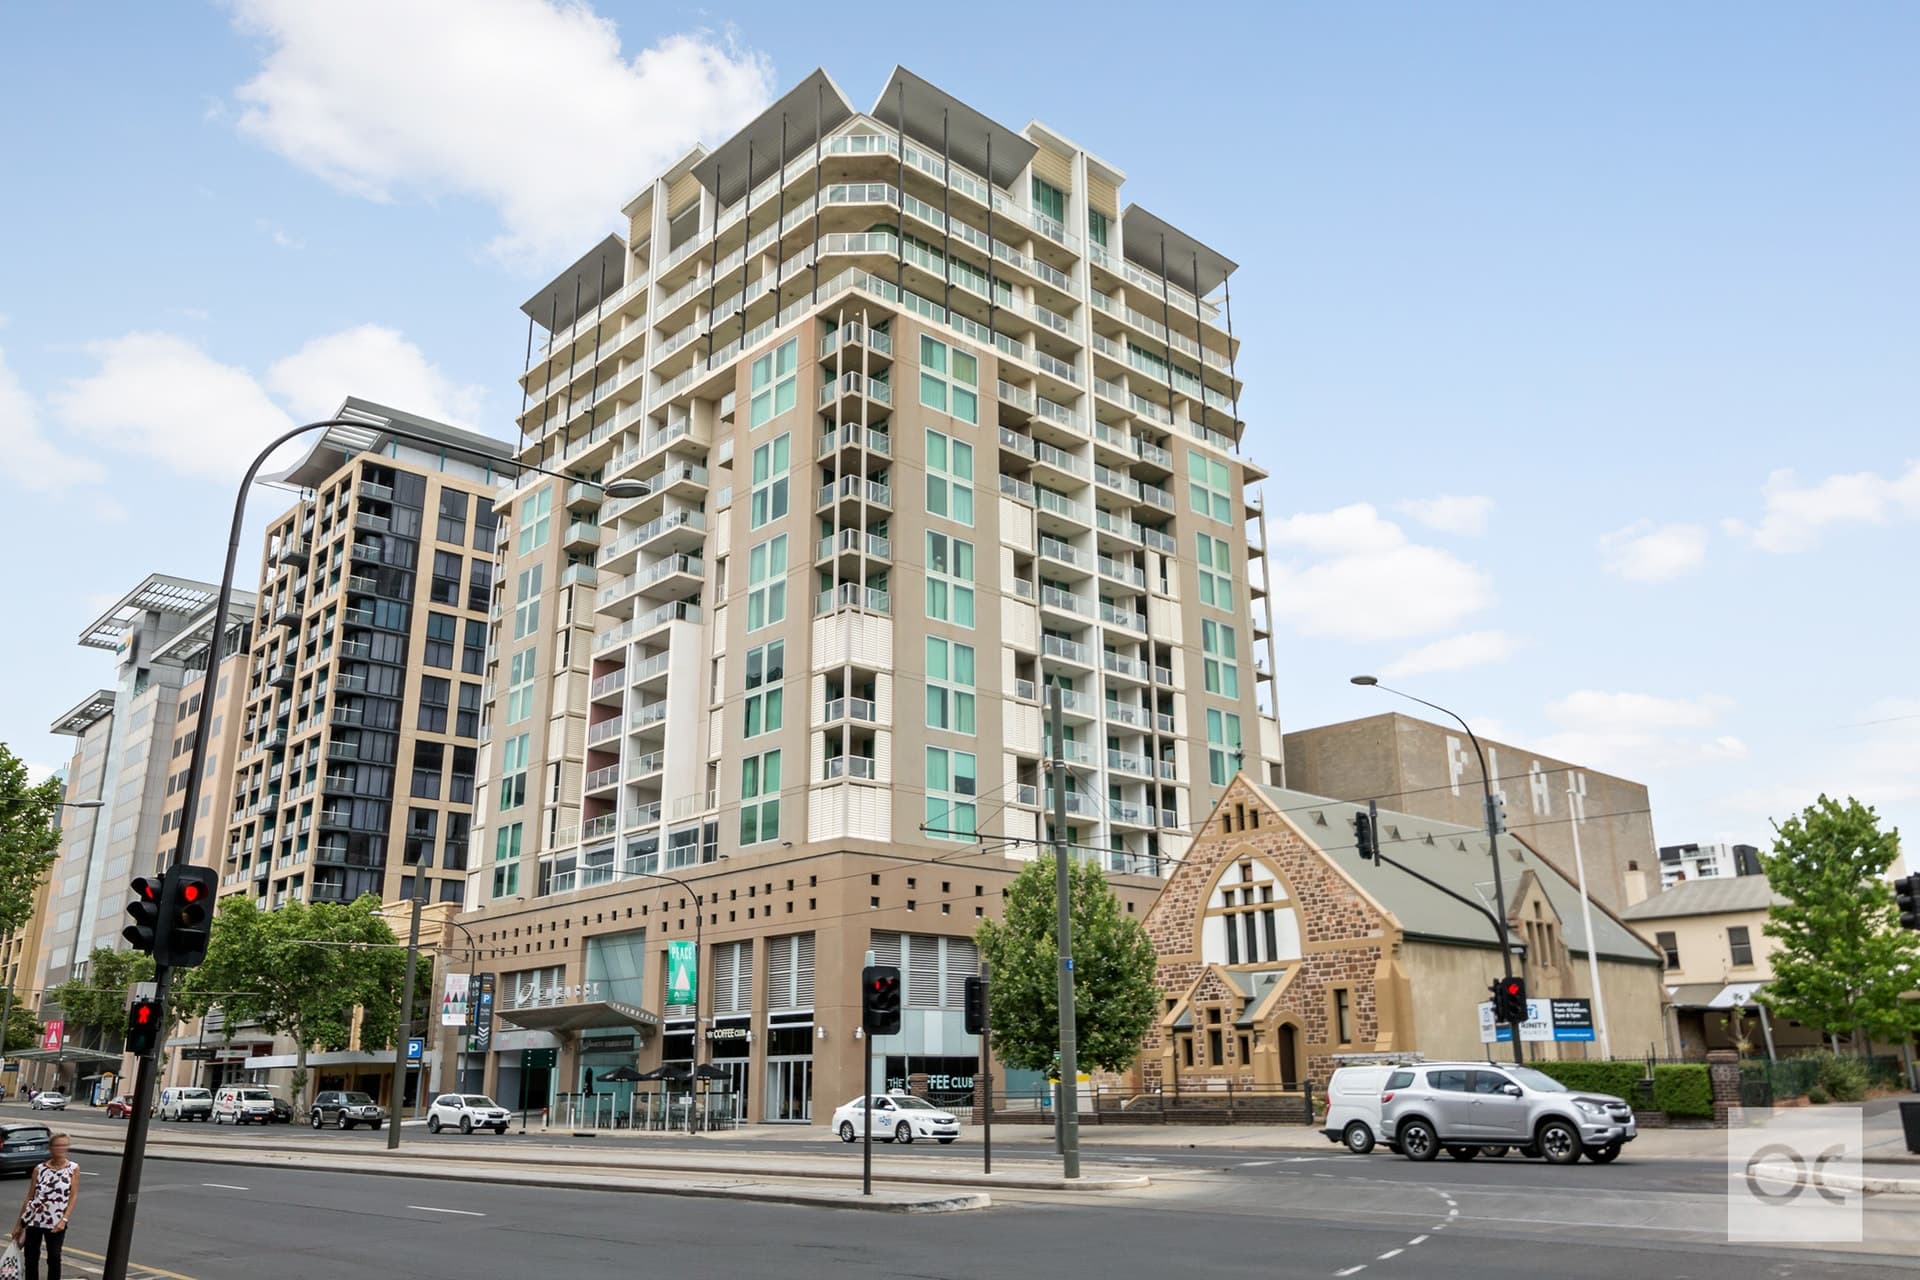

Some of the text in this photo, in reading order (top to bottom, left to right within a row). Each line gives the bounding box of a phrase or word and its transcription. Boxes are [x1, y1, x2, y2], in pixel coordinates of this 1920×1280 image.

[483, 994, 490, 1003] P
[408, 1043, 419, 1056] P
[951, 1076, 974, 1088] CLUB
